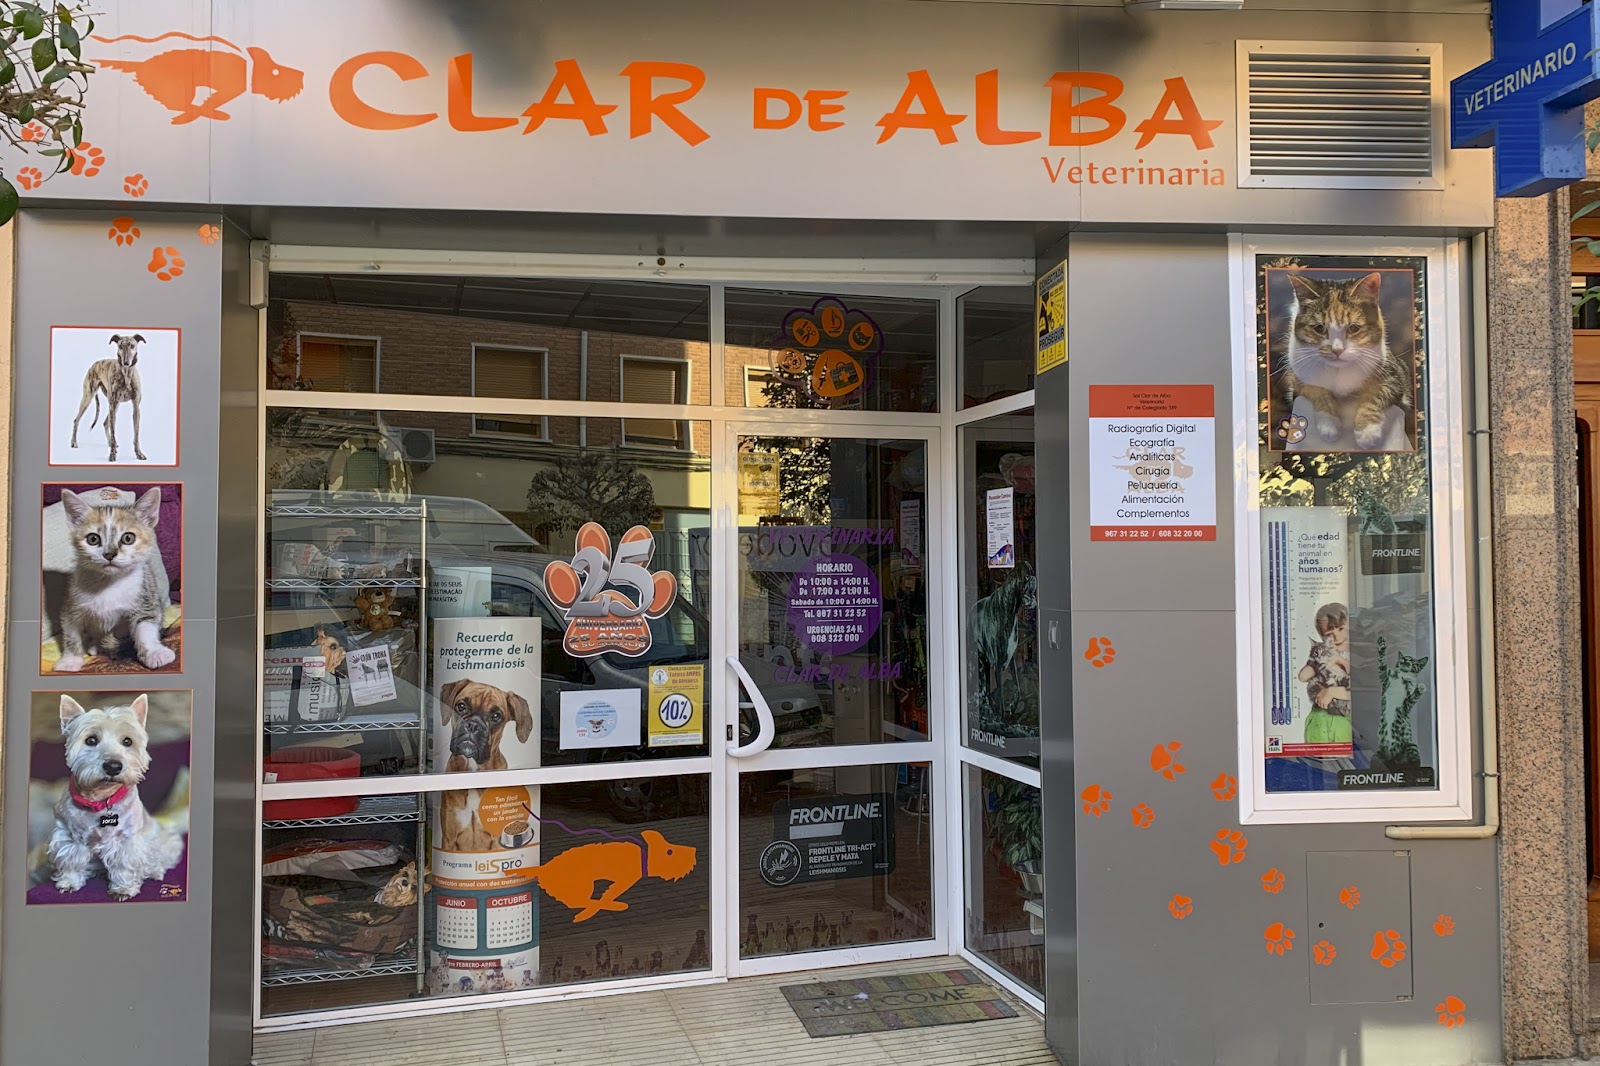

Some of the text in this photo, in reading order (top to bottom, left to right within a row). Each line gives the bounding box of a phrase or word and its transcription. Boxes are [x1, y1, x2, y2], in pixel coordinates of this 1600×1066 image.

[1464, 42, 1577, 116] VETERINARIO
[329, 51, 1225, 150] CLAR DE ALBA
[1041, 157, 1226, 186] Veterinaria
[1039, 327, 1064, 350] PROSEGUR
[1108, 424, 1196, 435] Radiografía Digital
[1130, 438, 1175, 449] Ecografía
[1130, 452, 1176, 462] Analíticas
[1135, 466, 1170, 477] Cirugía
[1128, 480, 1178, 491] Peluquería
[1122, 494, 1184, 504] Alimentación
[1116, 508, 1190, 519] Complementos
[769, 527, 894, 545] VETERINARIA
[1105, 530, 1118, 538] 967
[1119, 530, 1128, 538] 31
[1130, 530, 1139, 538] 22
[1140, 530, 1149, 538] 52
[1174, 530, 1182, 538] 32
[1184, 530, 1192, 538] 20
[1194, 530, 1203, 538] 00
[1318, 532, 1340, 540] edad
[816, 563, 854, 573] HORARIO
[1298, 565, 1344, 574] humanos?
[565, 538, 655, 618] 25
[799, 578, 808, 586] De
[810, 577, 832, 586] 10:00
[840, 577, 862, 586] 14:00
[862, 577, 870, 586] H.
[799, 588, 808, 596] De
[812, 587, 833, 596] 17:00
[842, 587, 862, 596] 21:00
[864, 587, 871, 596] H.
[816, 598, 824, 606] de
[826, 598, 845, 606] 10:00
[804, 610, 815, 618] Tel.
[834, 609, 843, 618] 31
[845, 609, 855, 618] 22
[856, 609, 867, 618] 52
[575, 618, 644, 631] ANIVERSARIO
[806, 626, 845, 634] URGENCIAS
[846, 626, 856, 634] 24
[456, 631, 514, 642] Recuerda
[568, 631, 648, 642] 25 AÑOS
[828, 634, 843, 642] 322
[845, 634, 860, 642] 000
[440, 644, 534, 659] protegerme de la
[446, 658, 525, 670] Leishmaniosis
[774, 662, 901, 683] CLAR DE ALBA
[661, 700, 688, 720] 10%
[808, 845, 846, 856] FRONTLINE
[442, 860, 472, 868] Programa
[809, 853, 860, 864] REPELE Y MATA
[809, 867, 847, 876] LEISHMANIOSIS
[445, 894, 528, 907] JUNIO OCTUBRE
[820, 988, 974, 1012] WECOME
